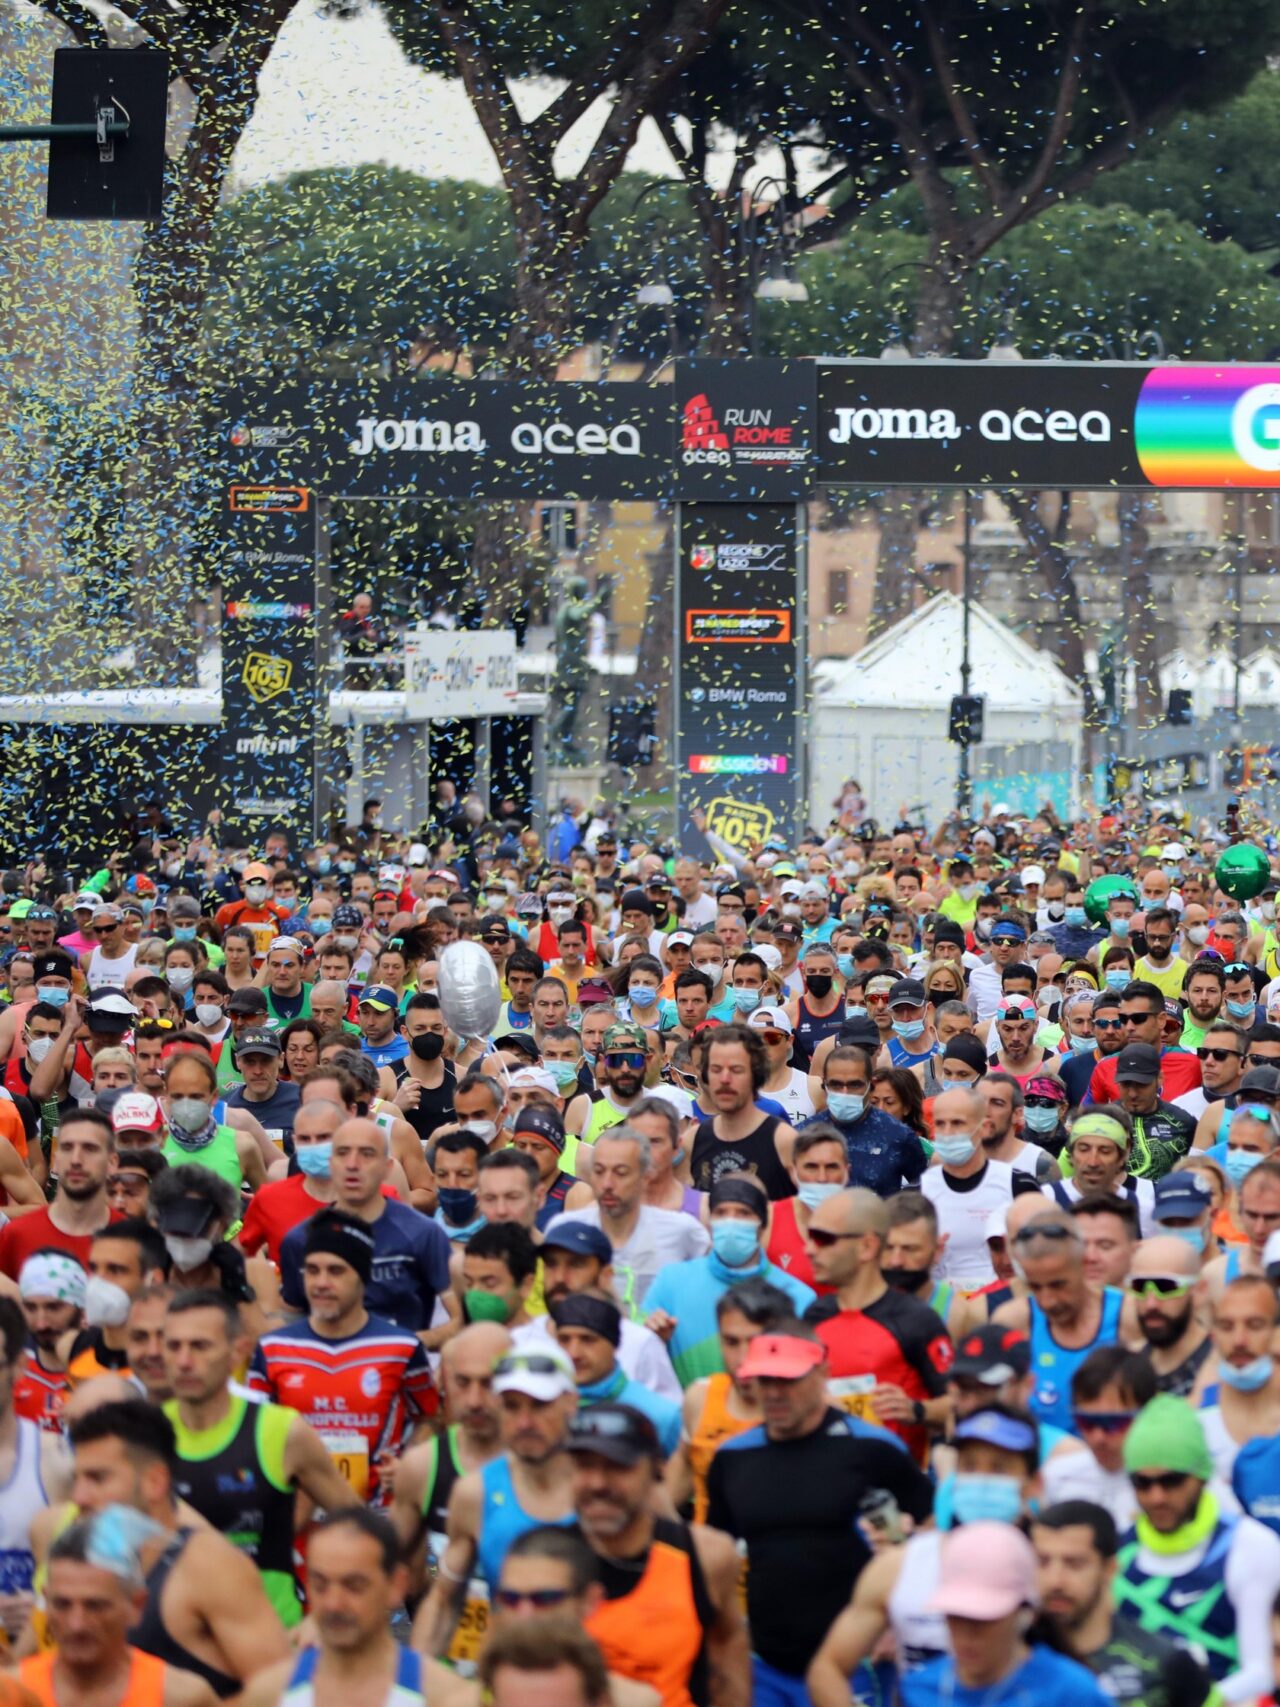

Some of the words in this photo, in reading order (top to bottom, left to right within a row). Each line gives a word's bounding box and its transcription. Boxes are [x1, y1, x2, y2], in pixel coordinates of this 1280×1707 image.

[724, 408, 772, 426] RUN
[979, 410, 1111, 442] acea
[511, 422, 641, 454] acea
[733, 427, 793, 444] ROME
[682, 450, 731, 463] acea
[708, 689, 745, 702] BMW
[747, 689, 787, 702] Roma
